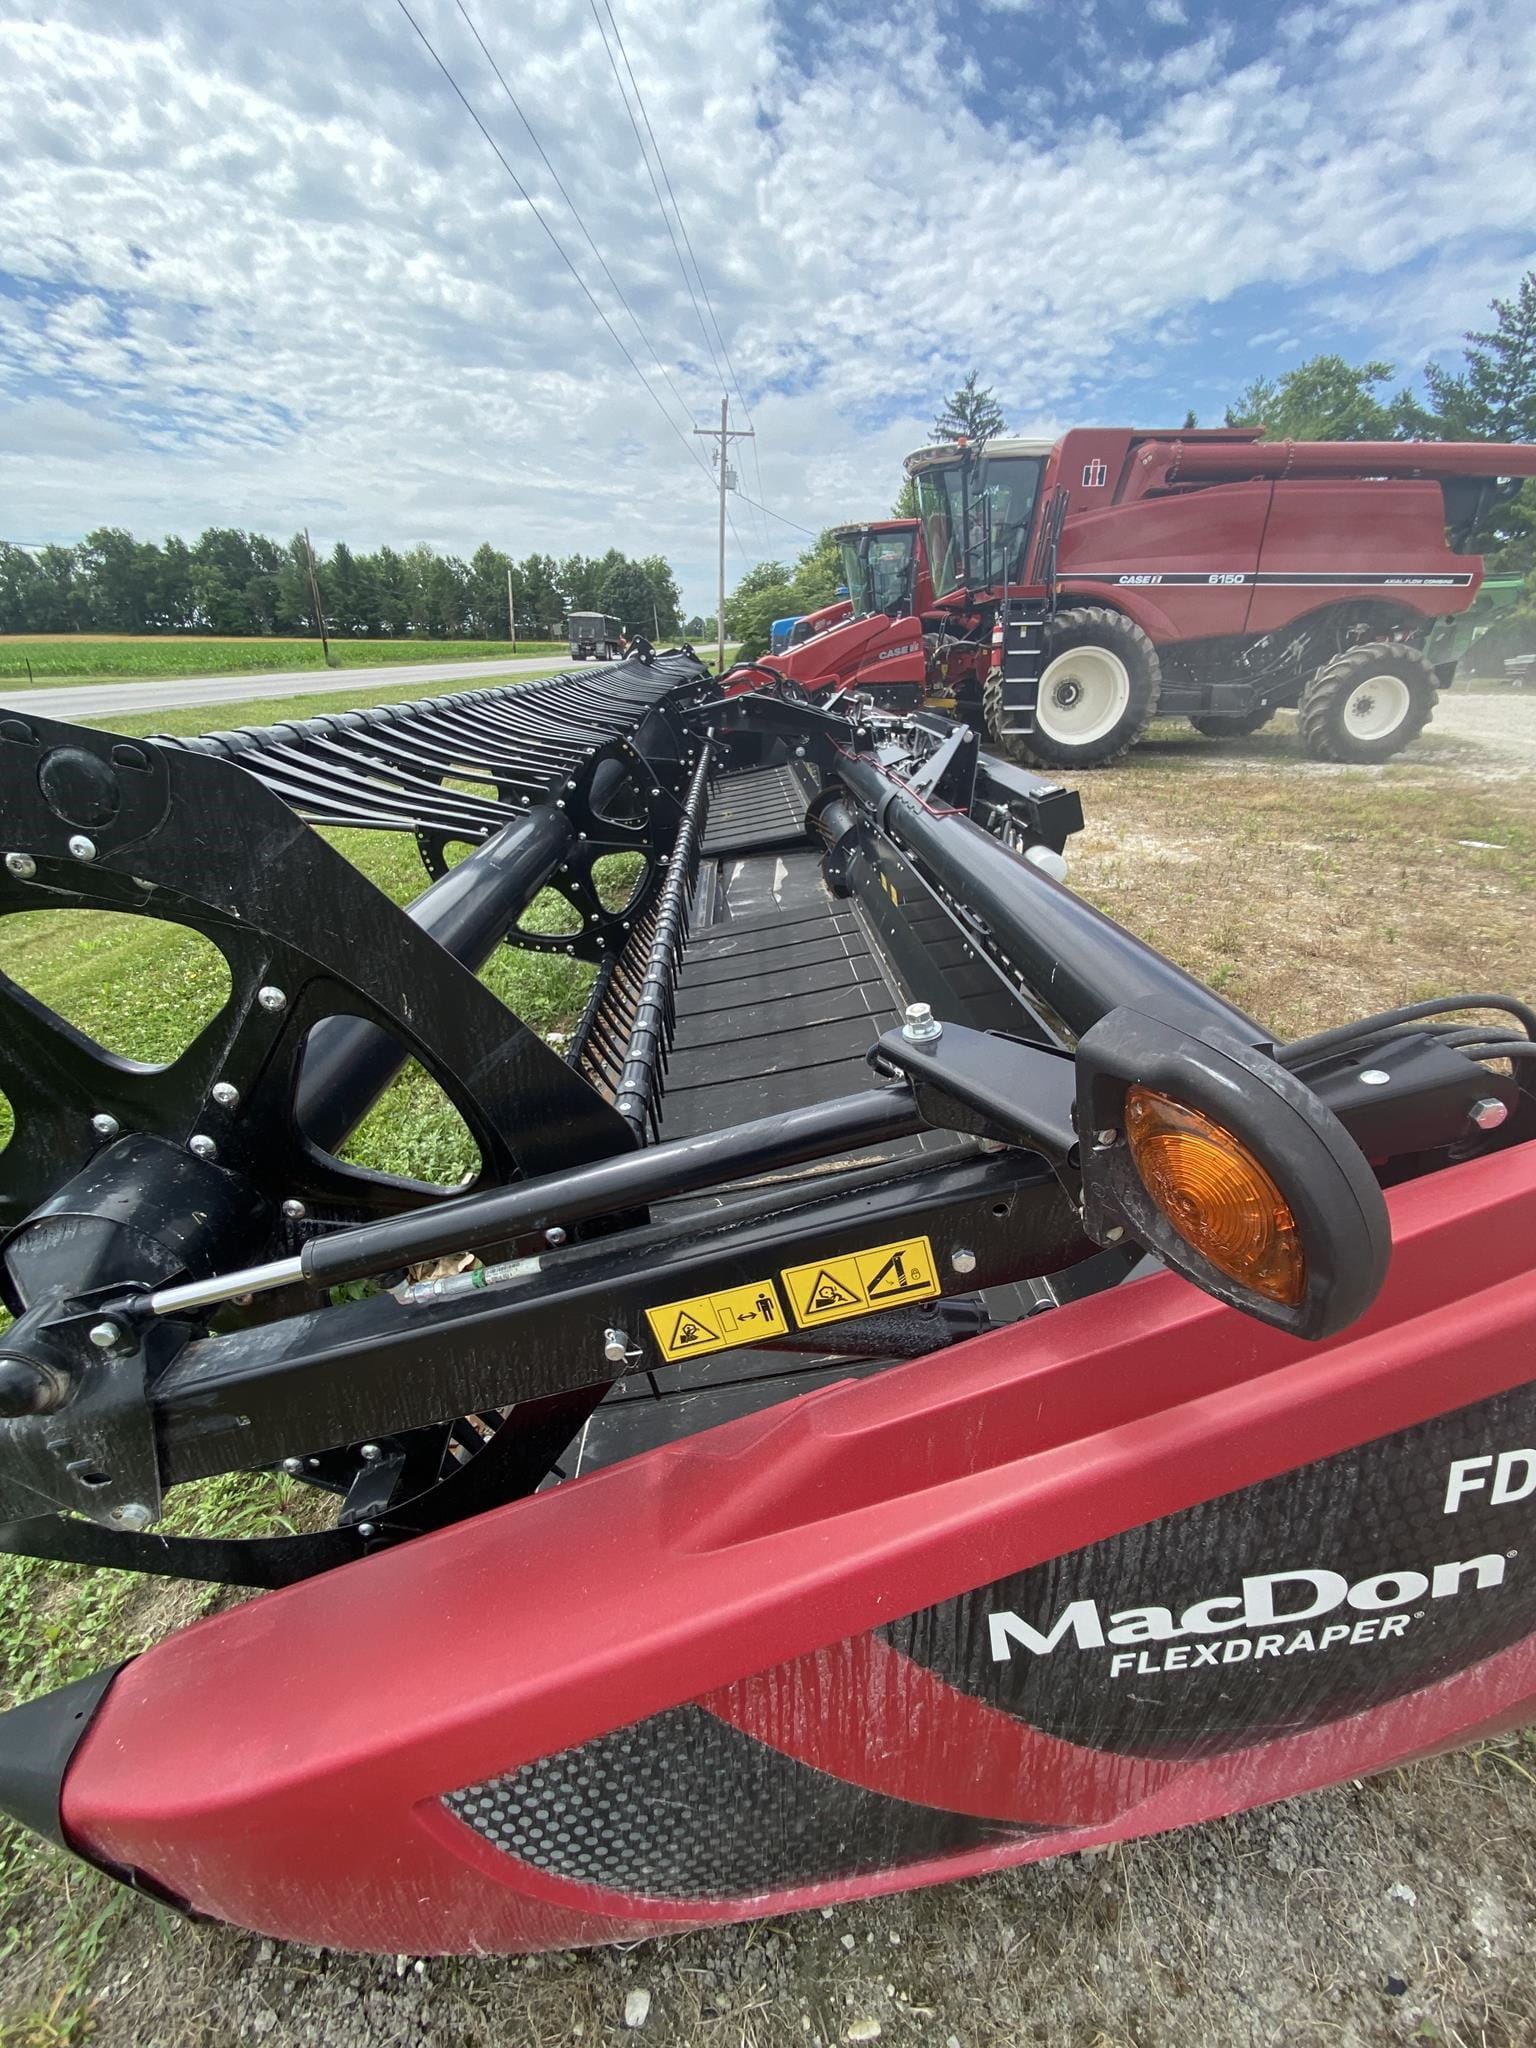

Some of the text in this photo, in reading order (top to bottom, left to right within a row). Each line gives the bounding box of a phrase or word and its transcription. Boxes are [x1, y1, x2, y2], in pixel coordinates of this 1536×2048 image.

[1208, 574, 1245, 584] 6150
[988, 1553, 1506, 1662] MacDon
[1110, 1614, 1411, 1678] FLEXDRAPER
